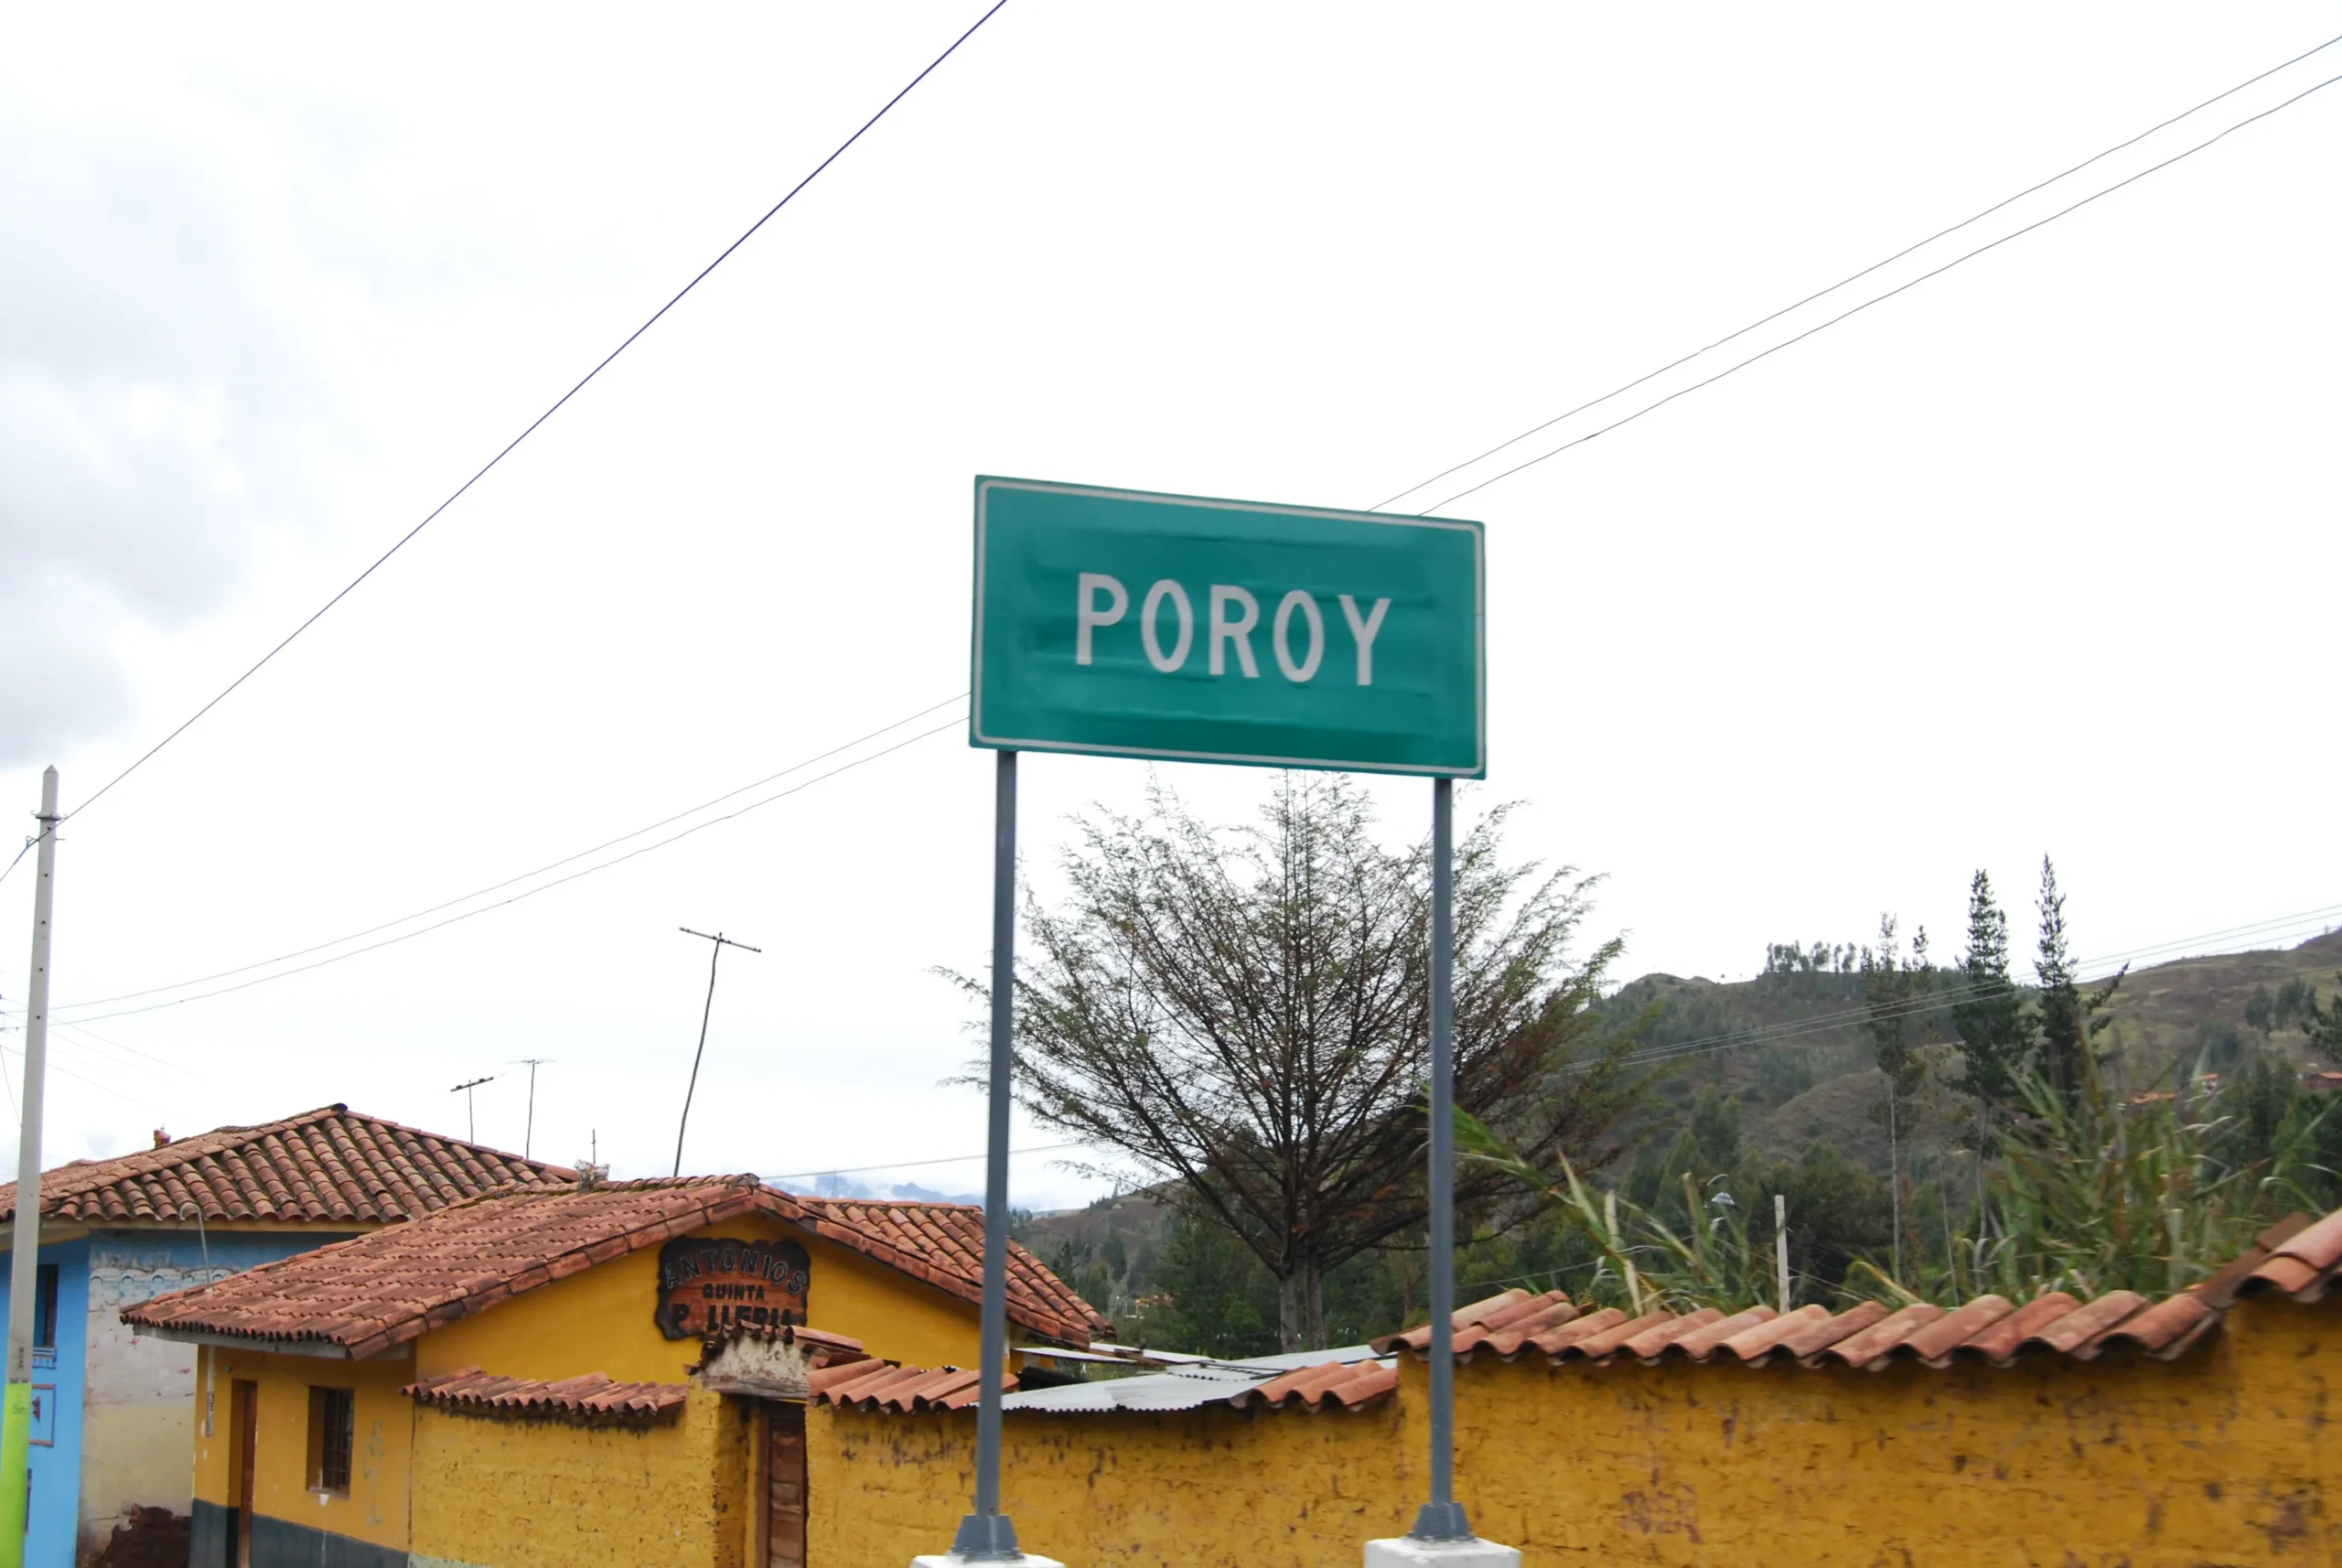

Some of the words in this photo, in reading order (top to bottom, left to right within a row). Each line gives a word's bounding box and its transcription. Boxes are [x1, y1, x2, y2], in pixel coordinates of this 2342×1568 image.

[1075, 572, 1392, 687] POROY
[665, 1249, 808, 1294] ANTONIOS
[703, 1283, 765, 1301] QUINTA
